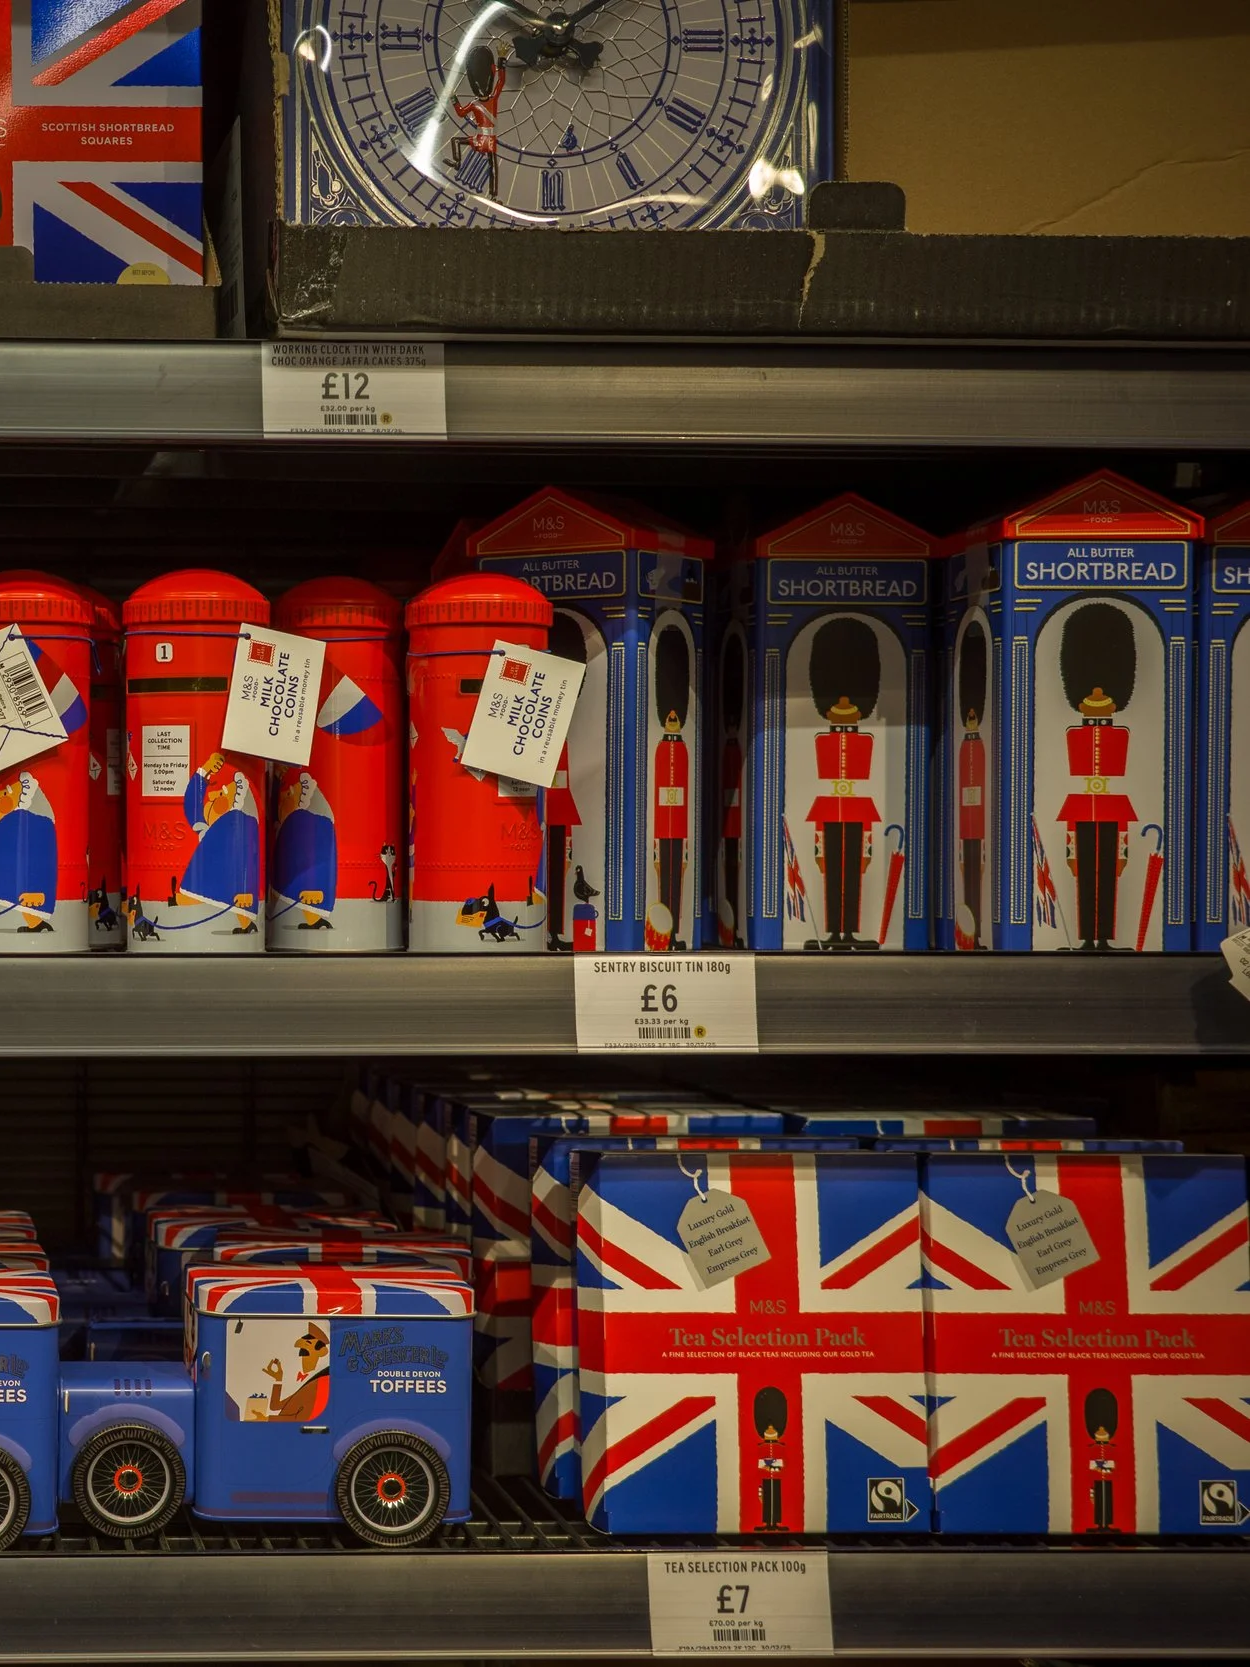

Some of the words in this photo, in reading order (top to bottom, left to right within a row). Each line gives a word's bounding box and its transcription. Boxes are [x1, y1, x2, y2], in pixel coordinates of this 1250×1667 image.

[41, 122, 96, 132] SCOTTISH
[99, 123, 175, 132] SHORTBREAD
[80, 136, 133, 145] SQUARES
[273, 345, 317, 354] WORKING
[320, 345, 350, 354] CLOCK
[354, 345, 369, 354] TIN
[372, 345, 396, 354] WITH
[399, 345, 424, 354] DARK
[271, 356, 297, 366] CHOC
[299, 356, 336, 366] ORANGE
[341, 356, 370, 366] JAFFA
[371, 356, 402, 366] CAKES
[404, 356, 426, 367] 375g
[321, 372, 370, 399] £12
[1083, 500, 1121, 515] M&S
[532, 516, 565, 531] M&S
[830, 522, 866, 536] M&S
[1067, 548, 1088, 558] ALL
[1090, 548, 1135, 558] BUTTER
[522, 562, 540, 572] ALL
[541, 560, 579, 570] BUTTER
[816, 566, 837, 575] ALL
[838, 566, 879, 576] BUTTER
[1025, 562, 1177, 581] SHORTBREAD
[777, 579, 917, 597] SHORTBREAD
[2, 673, 16, 693] 2930
[241, 675, 253, 700] M&S
[260, 676, 274, 707] MILK
[269, 652, 290, 735] CHOCOLATE
[284, 675, 299, 718] COINS
[553, 690, 564, 717] money
[487, 692, 503, 718] M&S
[507, 695, 525, 726] MILK
[513, 672, 546, 755] CHOCOLATE
[532, 696, 552, 738] COINS
[594, 961, 636, 973] SENTRY
[639, 961, 682, 973] BISCUIT
[685, 961, 702, 972] TIN
[706, 961, 730, 974] 180g
[640, 984, 678, 1012] £6
[687, 1214, 715, 1231] Luxury
[716, 1203, 735, 1218] Gold
[1016, 1215, 1043, 1231] Luxury
[1044, 1204, 1063, 1219] Gold
[688, 1231, 716, 1248] English
[715, 1215, 750, 1236] Breakfast
[1016, 1233, 1045, 1249] English
[1044, 1216, 1079, 1236] Breakfast
[707, 1244, 724, 1257] Earl
[724, 1237, 743, 1249] Grey
[1036, 1245, 1053, 1258] Earl
[1053, 1238, 1072, 1250] Grey
[706, 1255, 740, 1274] Empress
[740, 1246, 758, 1259] Grey
[1035, 1256, 1069, 1275] Empress
[1068, 1247, 1087, 1260] Grey
[749, 1299, 787, 1315] M&S
[1077, 1300, 1116, 1316] M&S
[338, 1326, 405, 1357] MARKS
[669, 1327, 706, 1346] Tea
[711, 1325, 808, 1347] Selection
[814, 1325, 866, 1347] Pack
[999, 1328, 1037, 1347] Tea
[1041, 1327, 1139, 1348] Selection
[1145, 1327, 1197, 1348] Pack
[360, 1345, 429, 1374] SPENCER
[377, 1370, 410, 1378] DOUBLE
[412, 1370, 441, 1378] DEVON
[369, 1380, 447, 1393] TOFFEES
[664, 1561, 685, 1573] TEA
[688, 1561, 747, 1573] SELECTION
[751, 1560, 779, 1572] PACK
[781, 1560, 806, 1574] 100g
[716, 1584, 750, 1613] £7
[738, 1620, 751, 1628] per
[753, 1620, 763, 1628] kg
